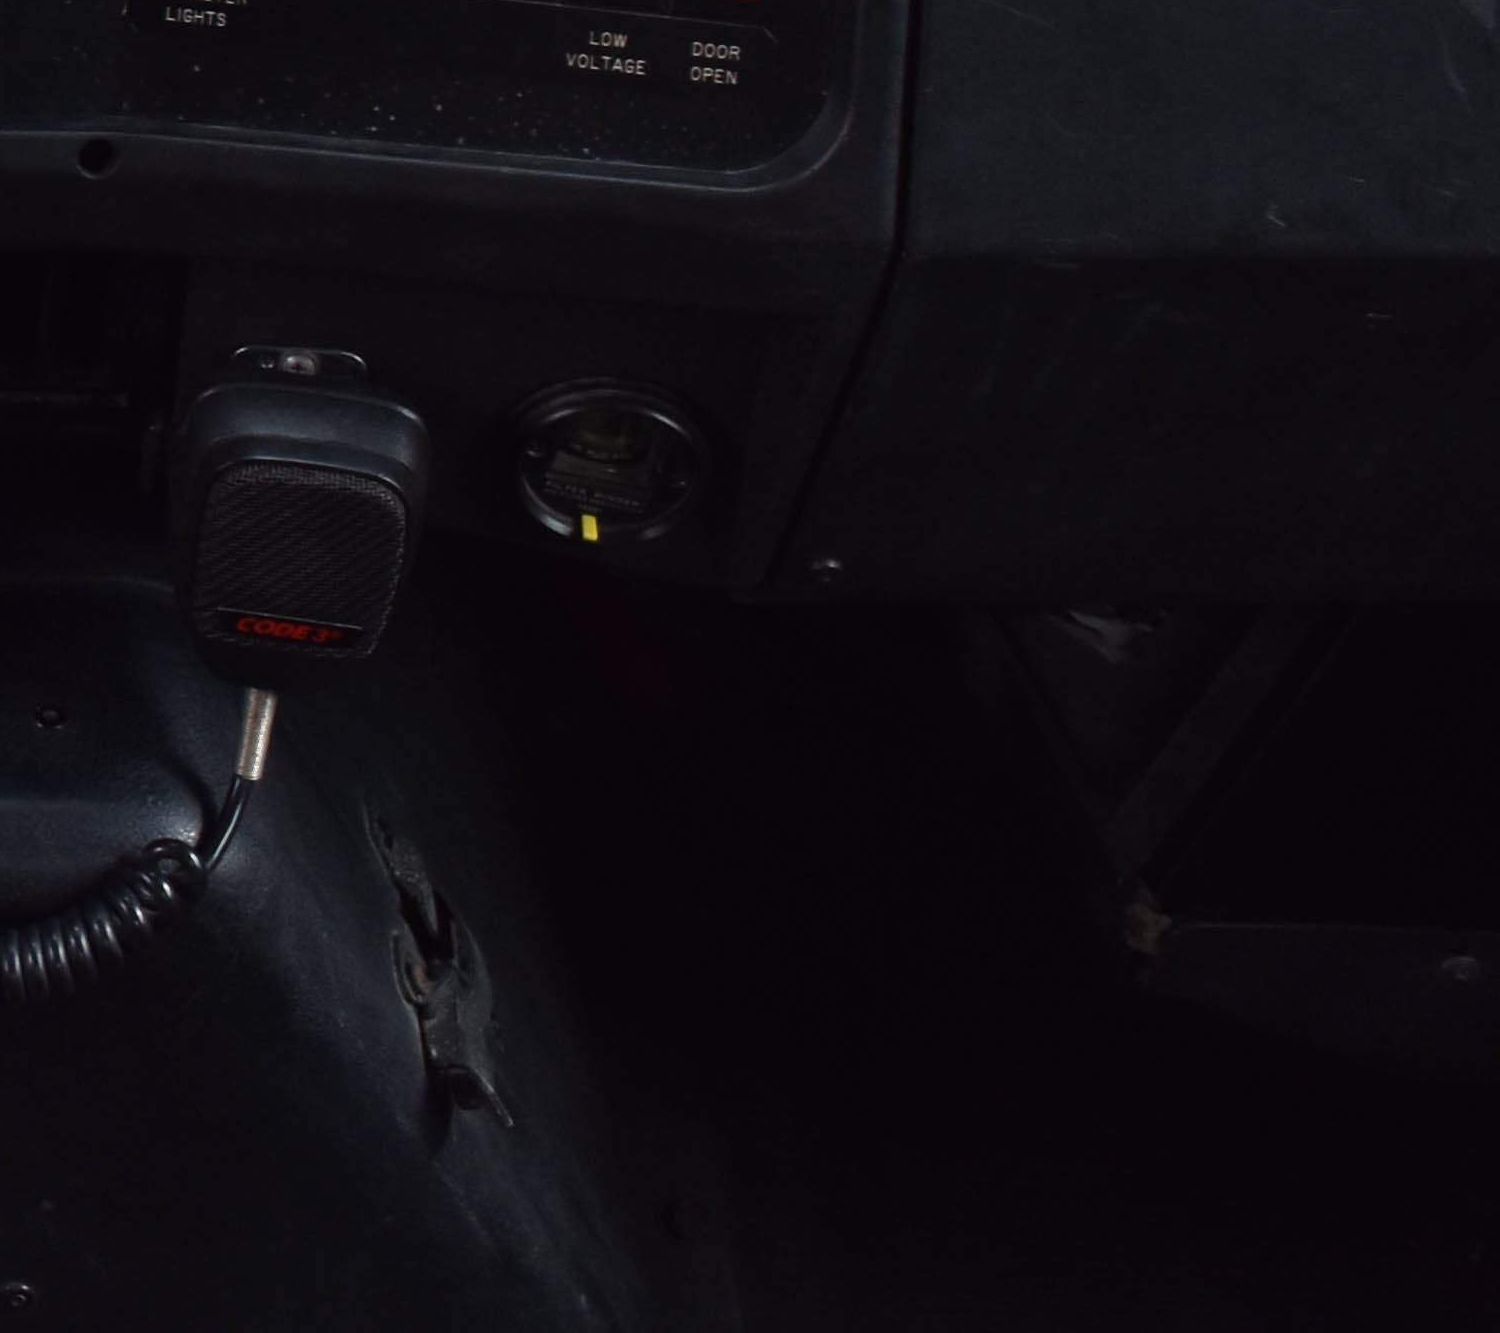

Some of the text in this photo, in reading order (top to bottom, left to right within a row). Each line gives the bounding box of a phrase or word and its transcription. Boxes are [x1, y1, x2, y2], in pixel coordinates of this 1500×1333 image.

[164, 6, 228, 28] LIGHTS
[589, 31, 628, 48] LOW
[691, 41, 741, 62] DOOR
[565, 51, 647, 76] VOLTAGE
[689, 65, 739, 85] OPEN
